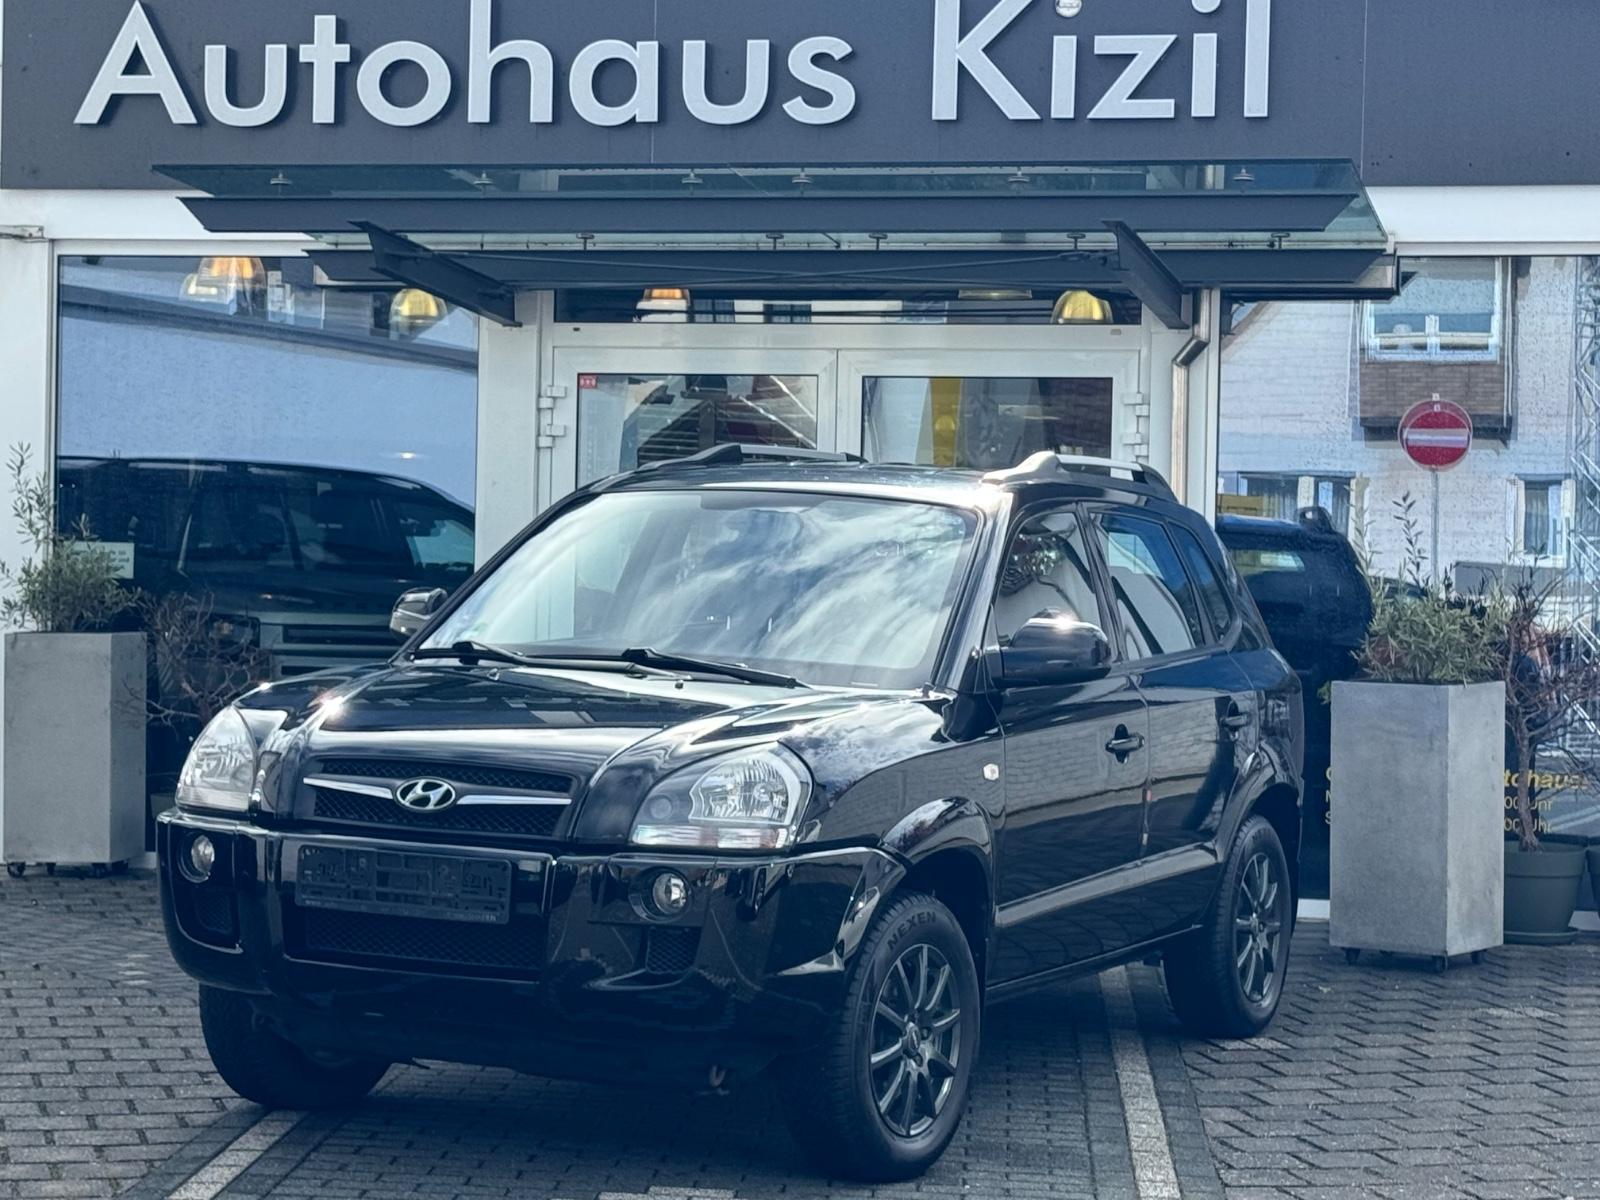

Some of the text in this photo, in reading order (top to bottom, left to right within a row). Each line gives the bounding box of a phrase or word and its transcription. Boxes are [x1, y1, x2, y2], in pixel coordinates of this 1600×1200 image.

[74, 0, 1271, 126] Autohaus Kizil
[887, 911, 937, 949] NEXEN
